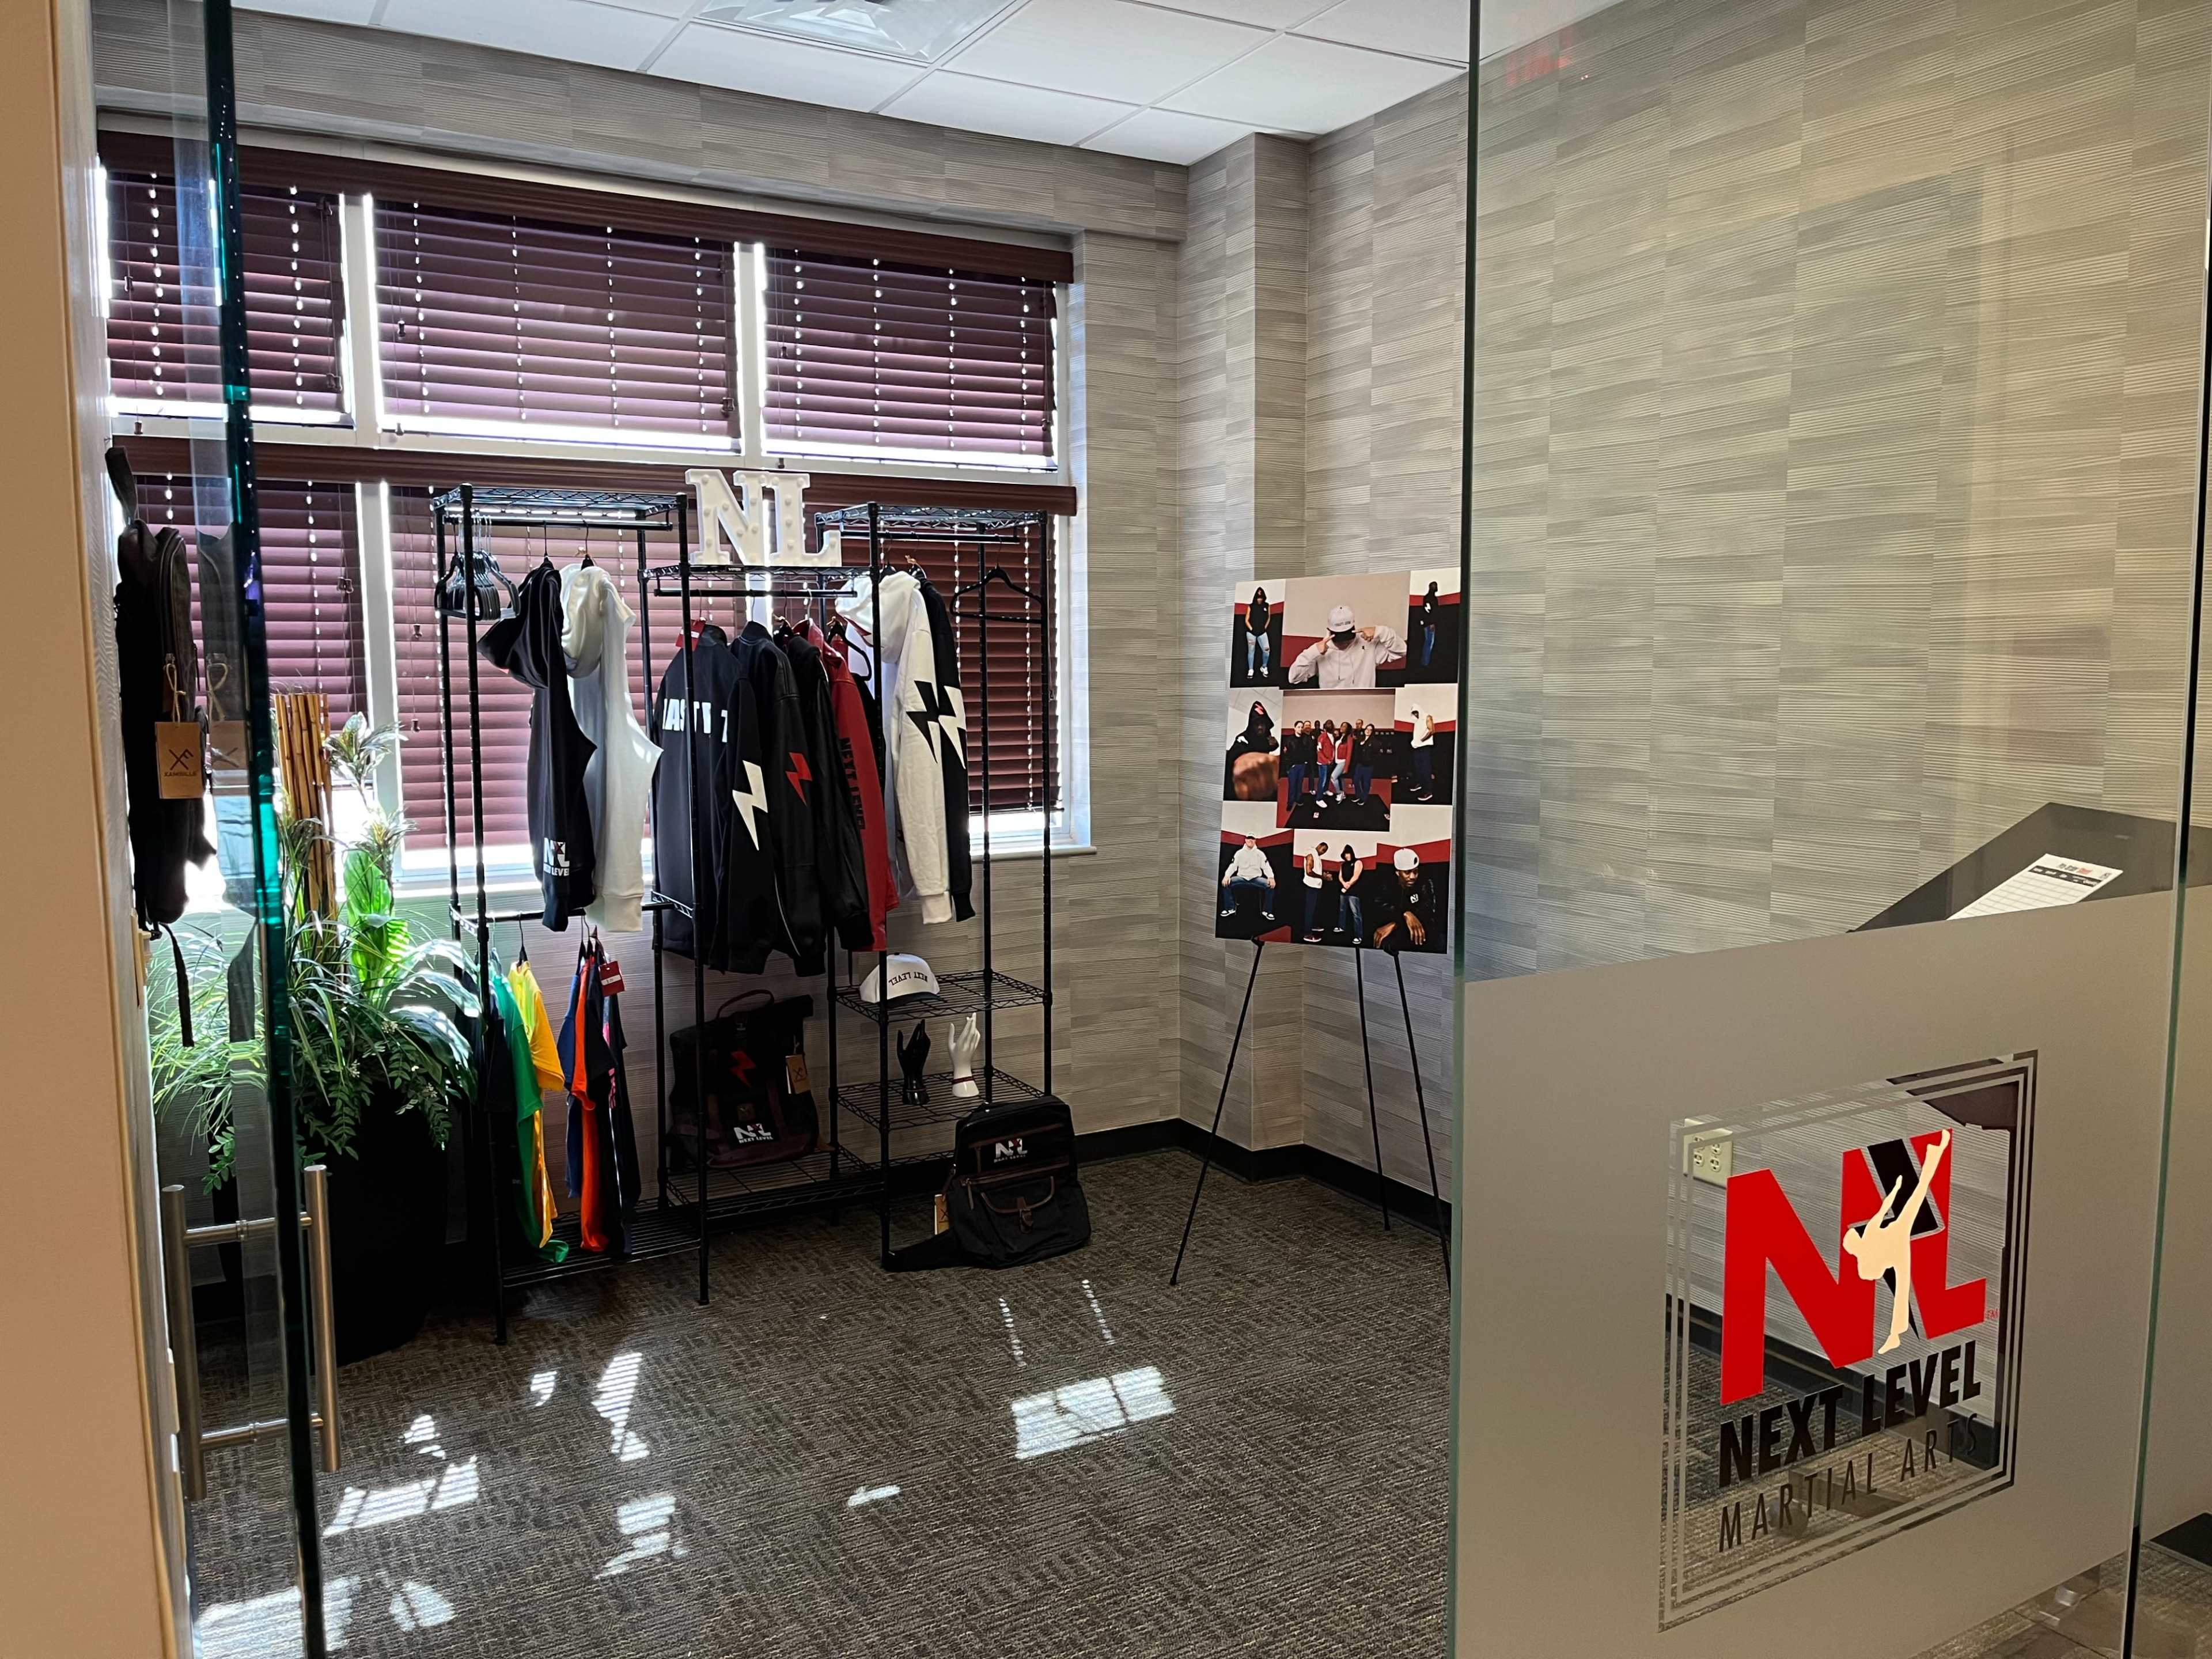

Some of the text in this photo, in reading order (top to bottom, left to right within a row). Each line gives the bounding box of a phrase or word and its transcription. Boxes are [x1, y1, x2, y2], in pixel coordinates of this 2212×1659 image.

[685, 469, 842, 567] NL
[888, 972, 928, 986] NEXT LEVEL
[1718, 1340, 1982, 1488] NEXT LEVEL
[1718, 1412, 1978, 1554] MARTIAL ARTS
